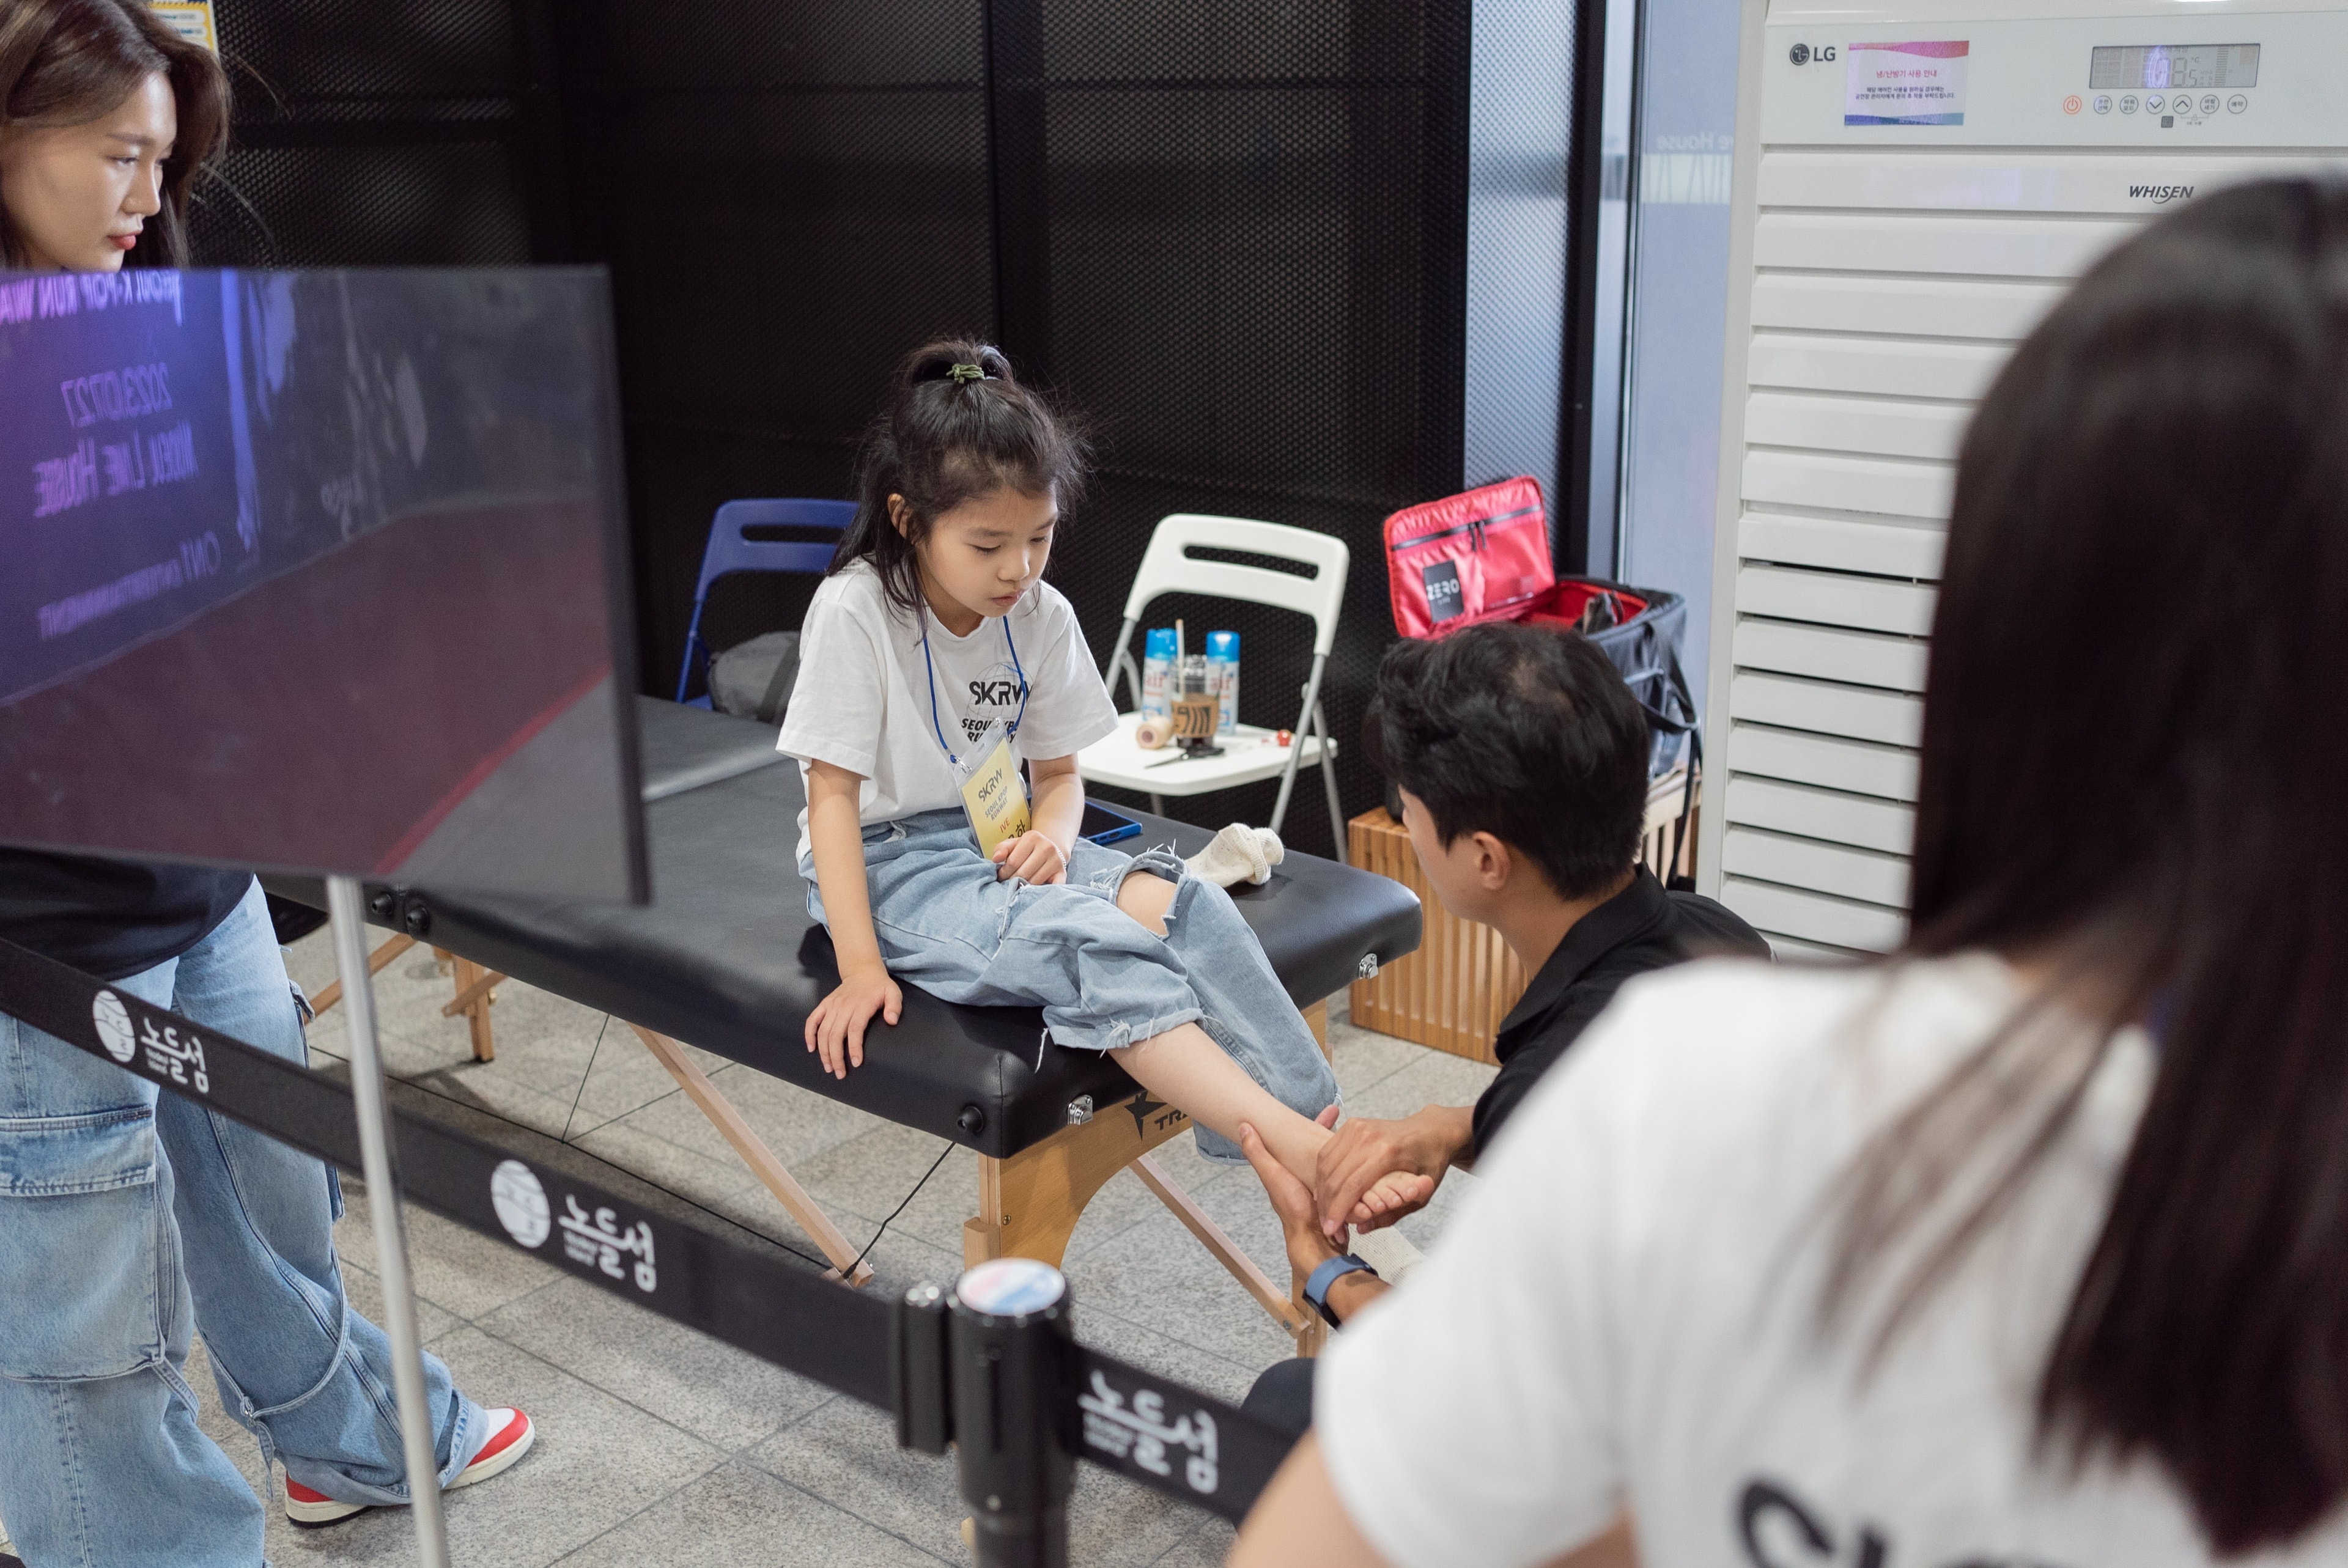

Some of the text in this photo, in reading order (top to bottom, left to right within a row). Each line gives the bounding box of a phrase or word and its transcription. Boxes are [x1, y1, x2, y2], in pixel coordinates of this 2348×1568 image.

[1814, 46, 1836, 62] LG
[1908, 69, 1921, 78] 사용
[1924, 69, 1937, 78] 안내
[2130, 185, 2195, 199] WHISEN
[1426, 578, 1460, 601] ZERO
[961, 718, 992, 732] SEOU
[978, 768, 1003, 802] SKRW
[985, 786, 1008, 818] SEOUL KPOP
[991, 797, 1008, 821] RUNWAY
[1000, 817, 1010, 833] IVE
